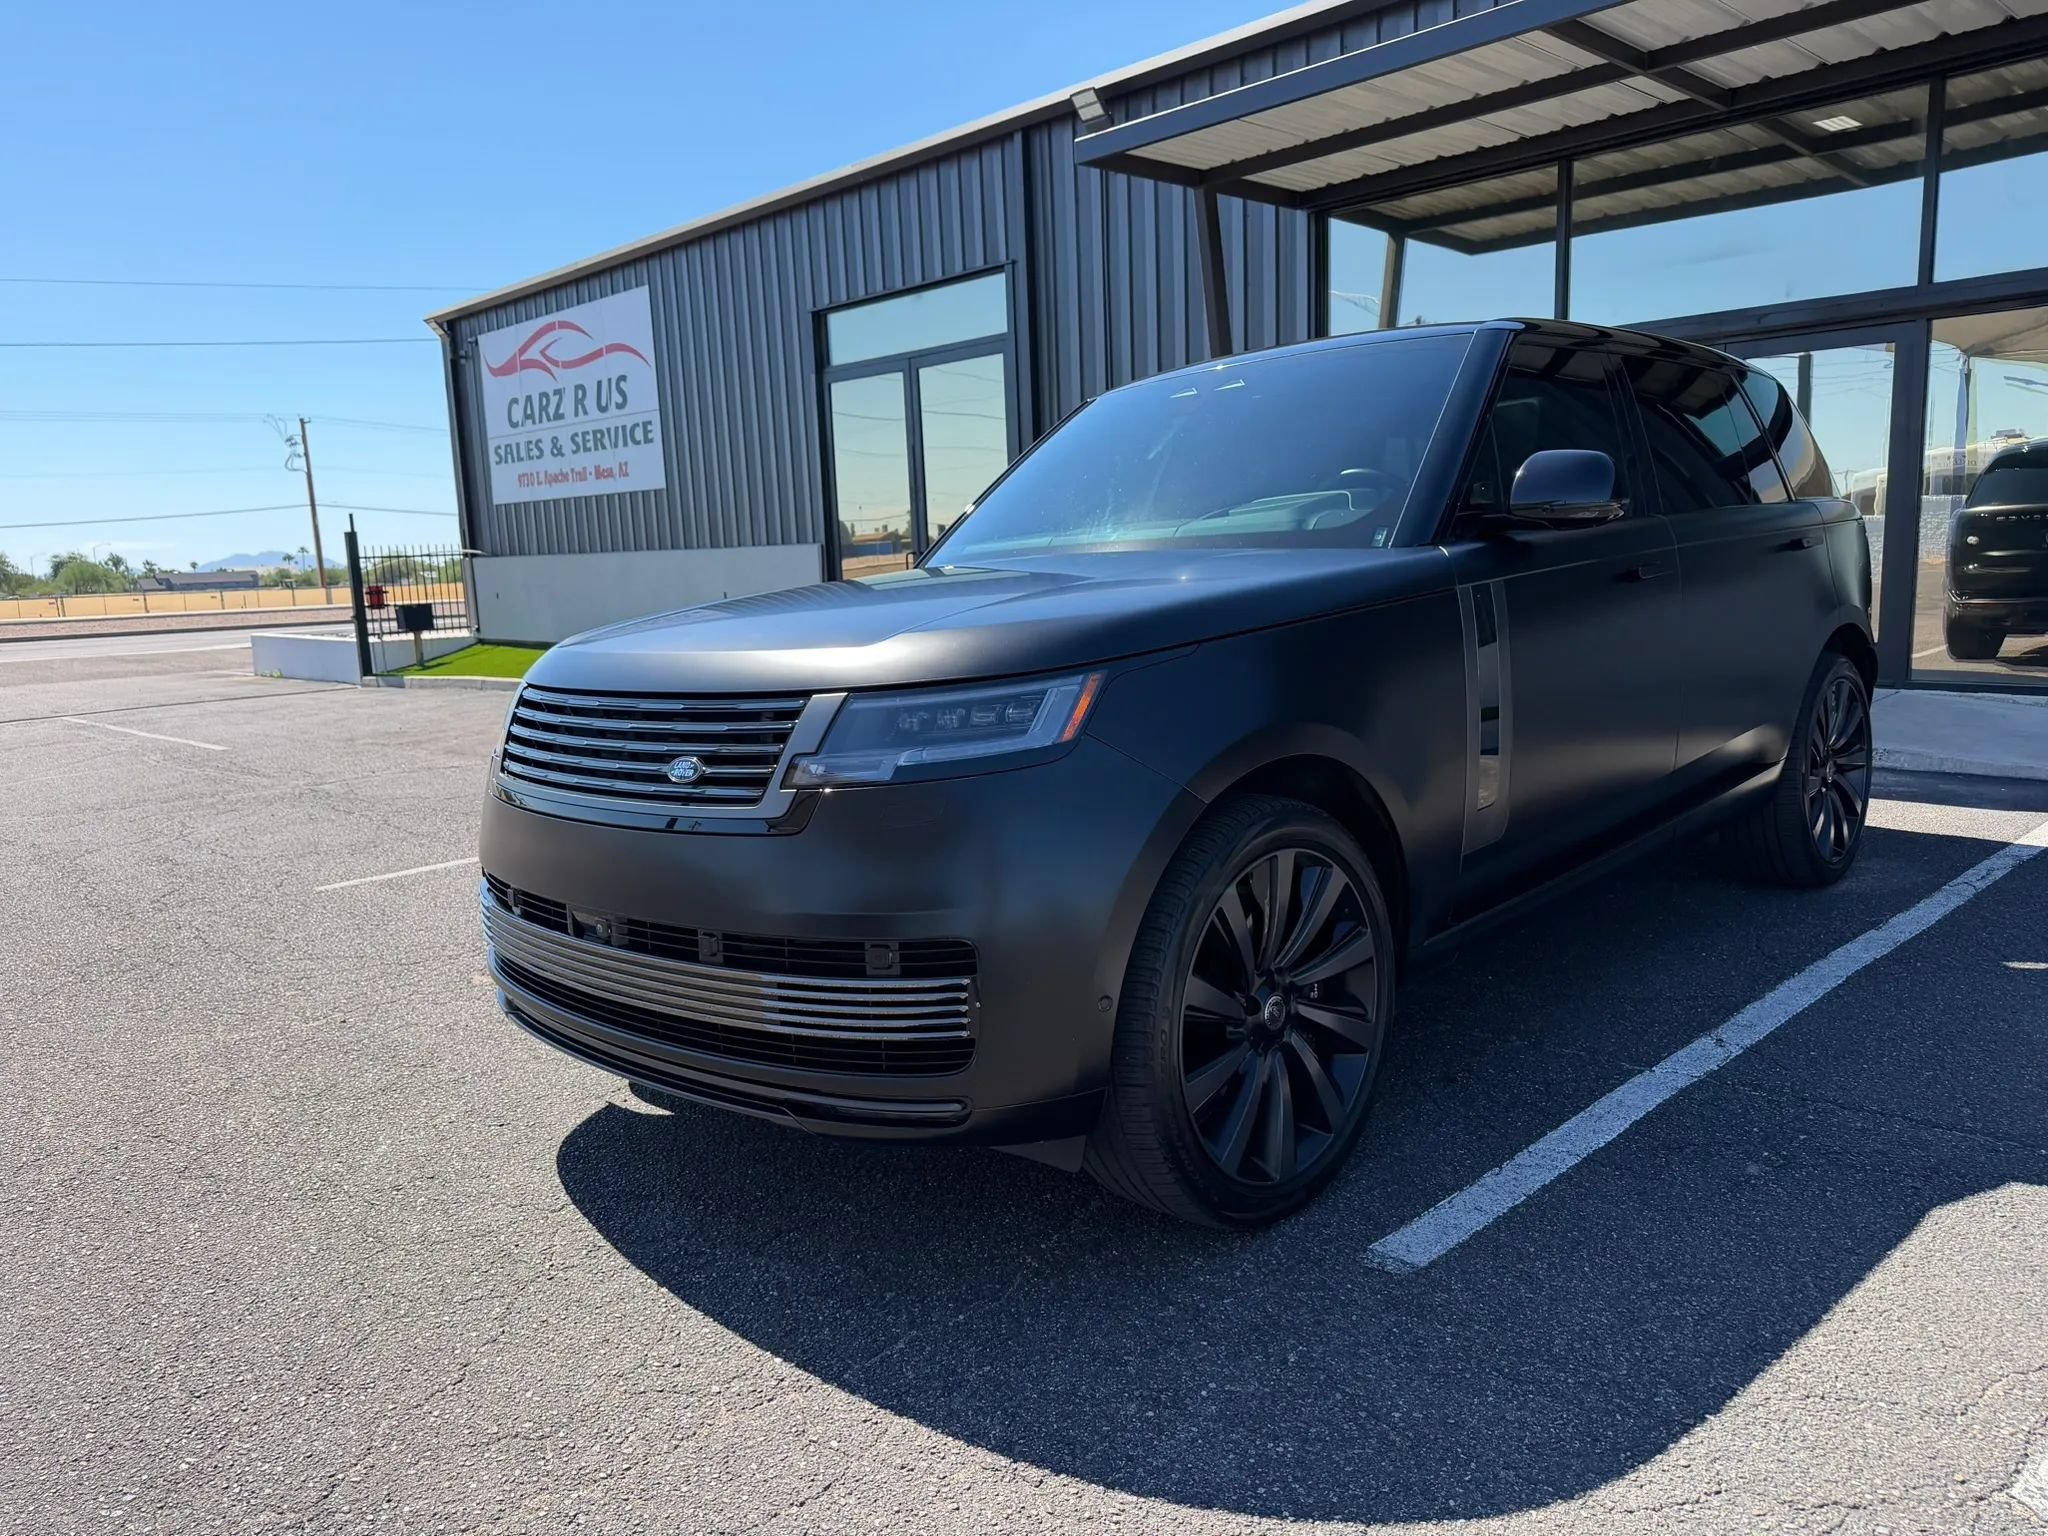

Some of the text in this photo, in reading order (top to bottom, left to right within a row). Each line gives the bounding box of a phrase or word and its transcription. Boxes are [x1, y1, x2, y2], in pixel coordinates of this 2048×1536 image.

[573, 383, 589, 418] R
[596, 374, 628, 413] US
[494, 420, 655, 466] SALES & SERVICE
[570, 463, 588, 482] Trail
[618, 461, 630, 478] AZ
[673, 769, 694, 777] ROVER
[674, 761, 691, 769] LAND
